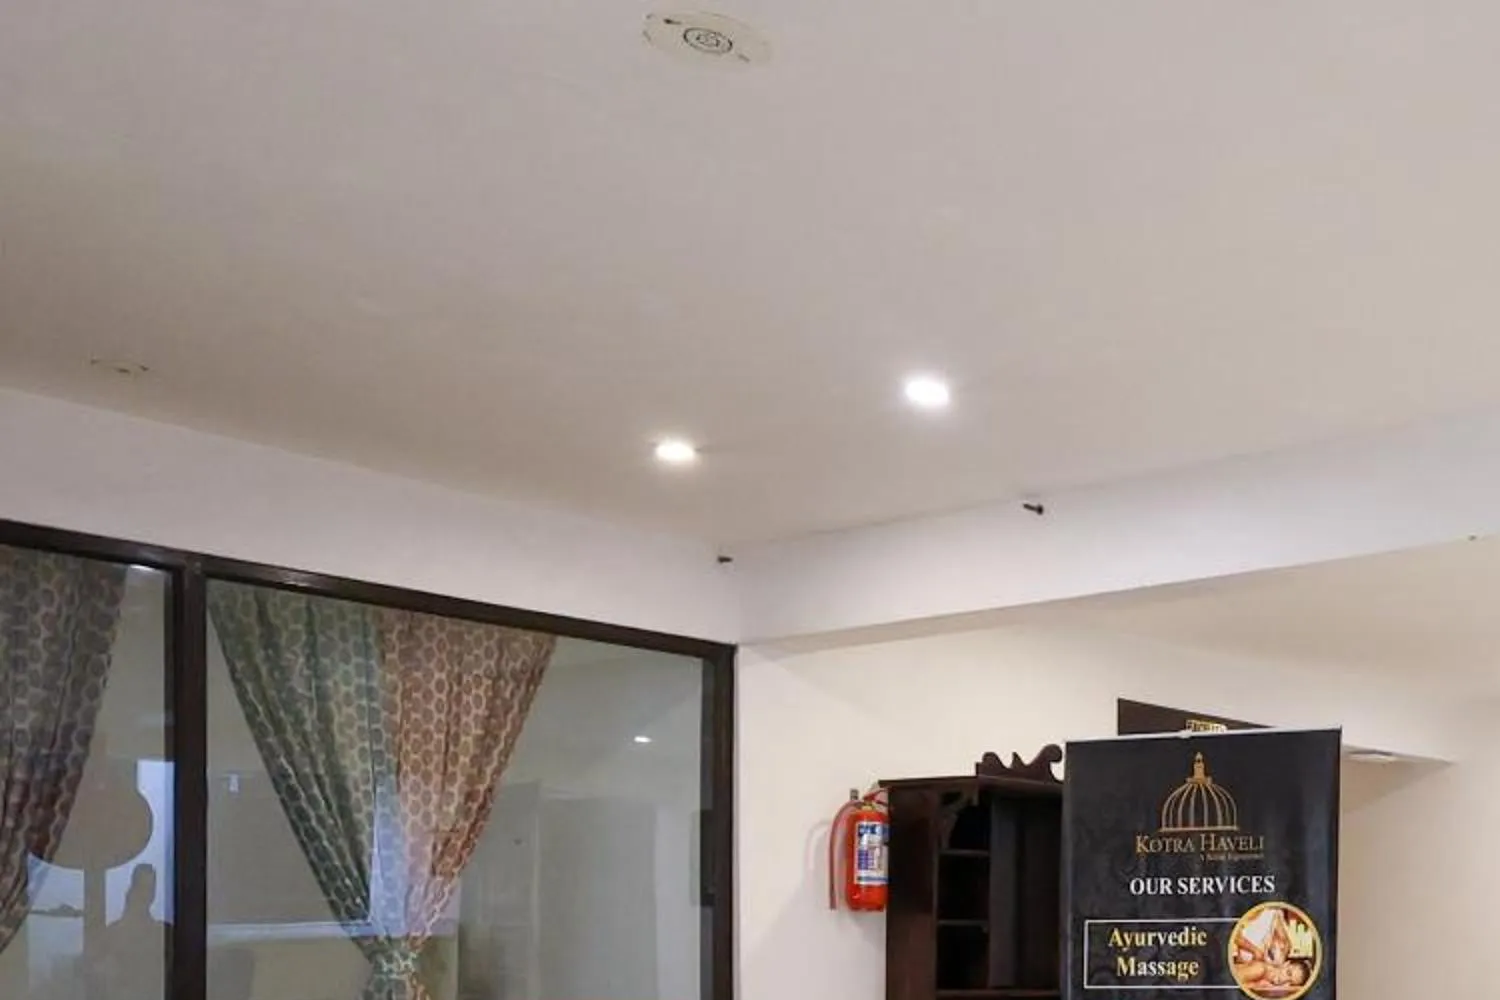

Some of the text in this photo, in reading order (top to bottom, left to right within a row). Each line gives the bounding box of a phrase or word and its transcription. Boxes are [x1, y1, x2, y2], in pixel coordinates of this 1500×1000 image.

[1135, 832, 1264, 853] KOTRA HAVELI
[1130, 875, 1275, 895] OUR SERVICES
[1108, 927, 1207, 952] Ayurvedic
[1116, 957, 1199, 981] Massage
